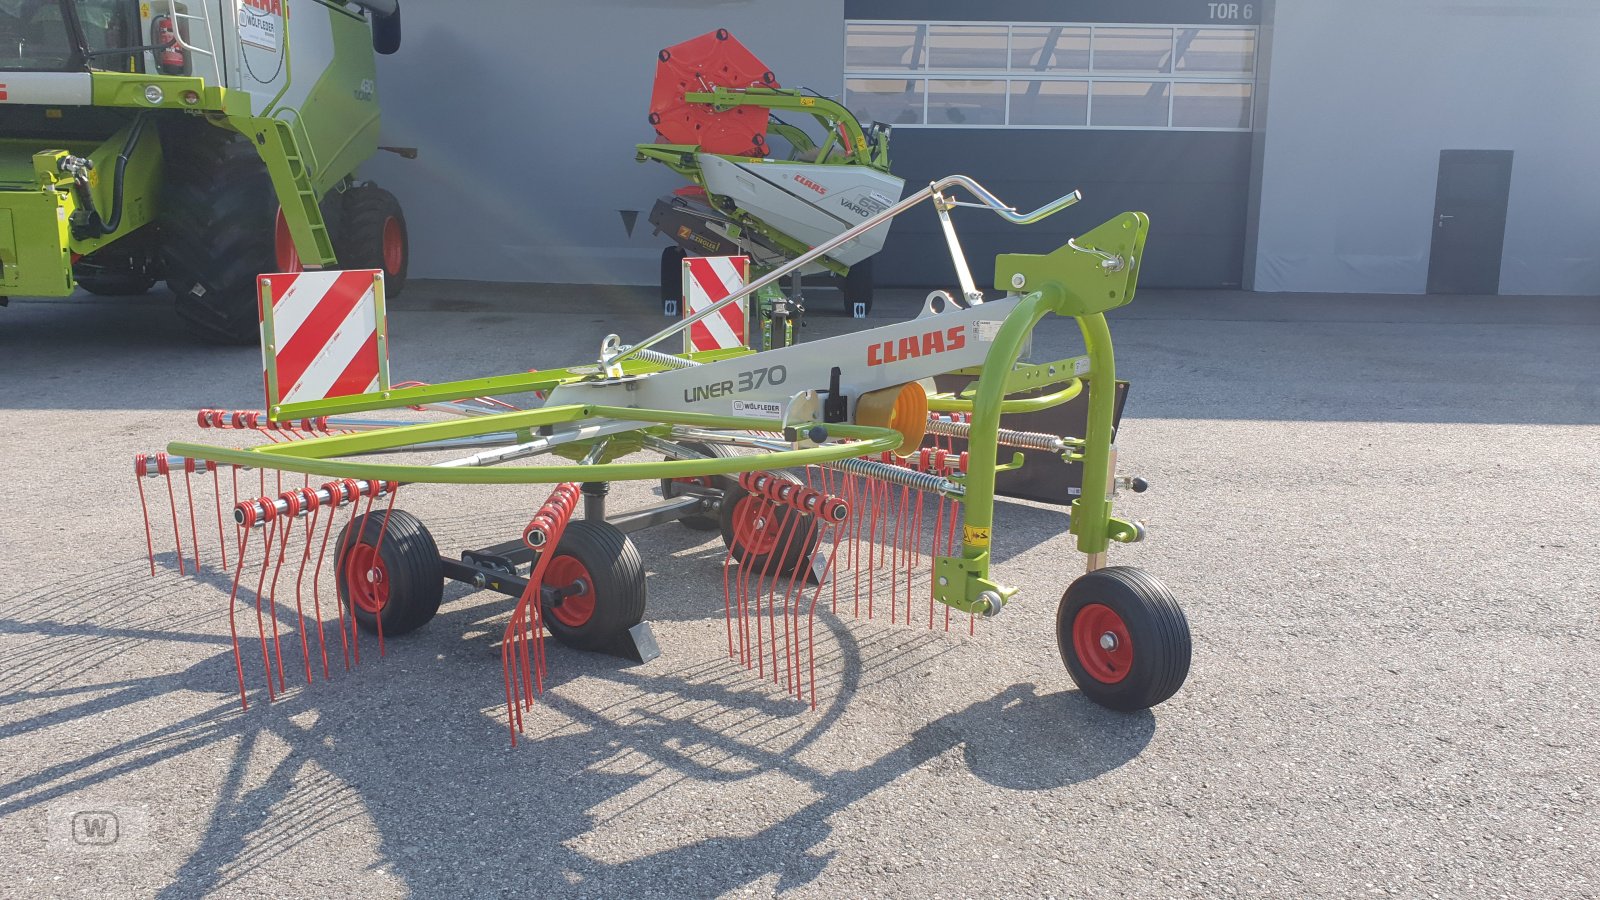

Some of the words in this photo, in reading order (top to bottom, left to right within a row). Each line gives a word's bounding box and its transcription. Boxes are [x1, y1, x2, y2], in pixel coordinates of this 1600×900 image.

[1208, 3, 1238, 19] TOR
[1243, 4, 1253, 19] 6
[793, 174, 828, 195] CLAAS
[840, 198, 869, 218] VARIO
[867, 325, 965, 367] CLAAS
[684, 380, 734, 403] LINER
[738, 364, 787, 392] 370
[744, 403, 780, 411] WÖLFLEDER
